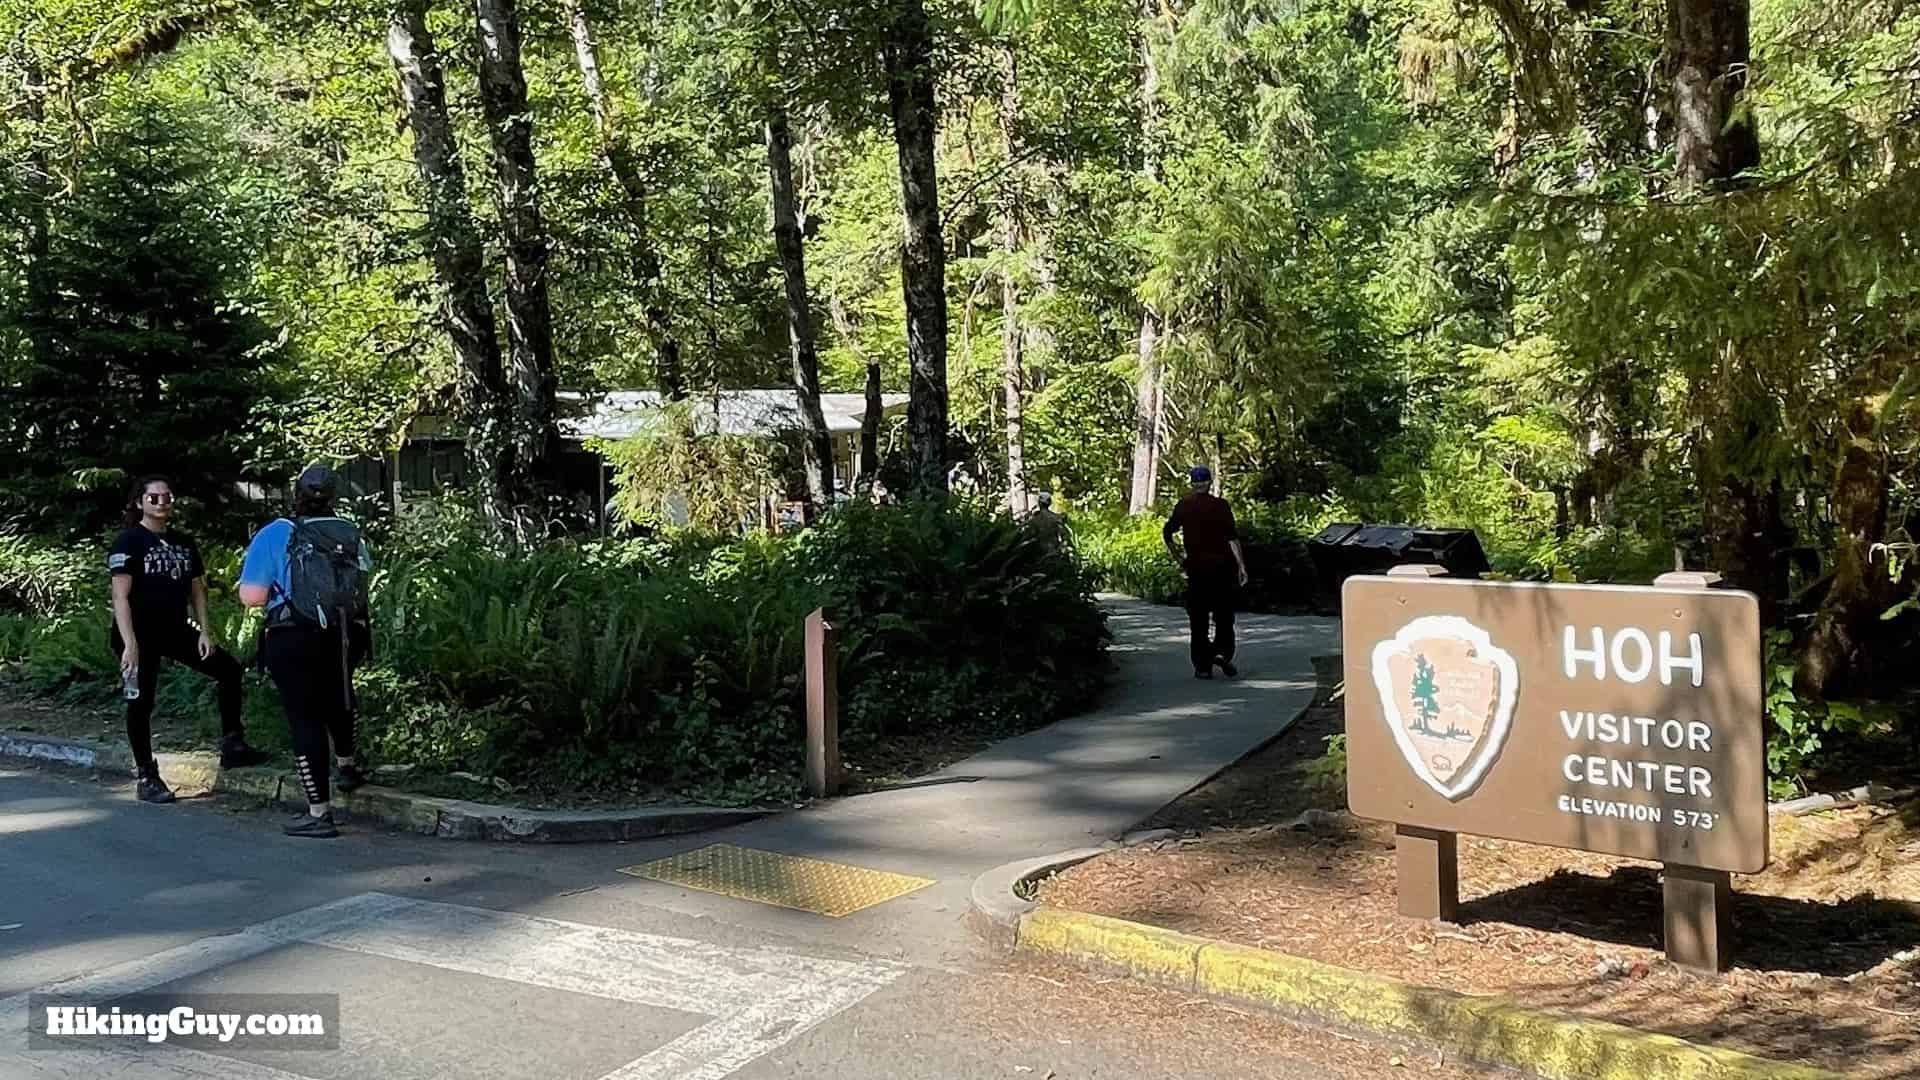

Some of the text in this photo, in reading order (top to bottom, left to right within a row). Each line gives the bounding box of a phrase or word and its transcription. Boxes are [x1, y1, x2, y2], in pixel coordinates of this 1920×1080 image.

[1563, 625, 1703, 687] HOH
[1559, 710, 1713, 752] VISITOR
[1563, 754, 1713, 798] CENTER
[1558, 795, 1662, 823] ELEVATION
